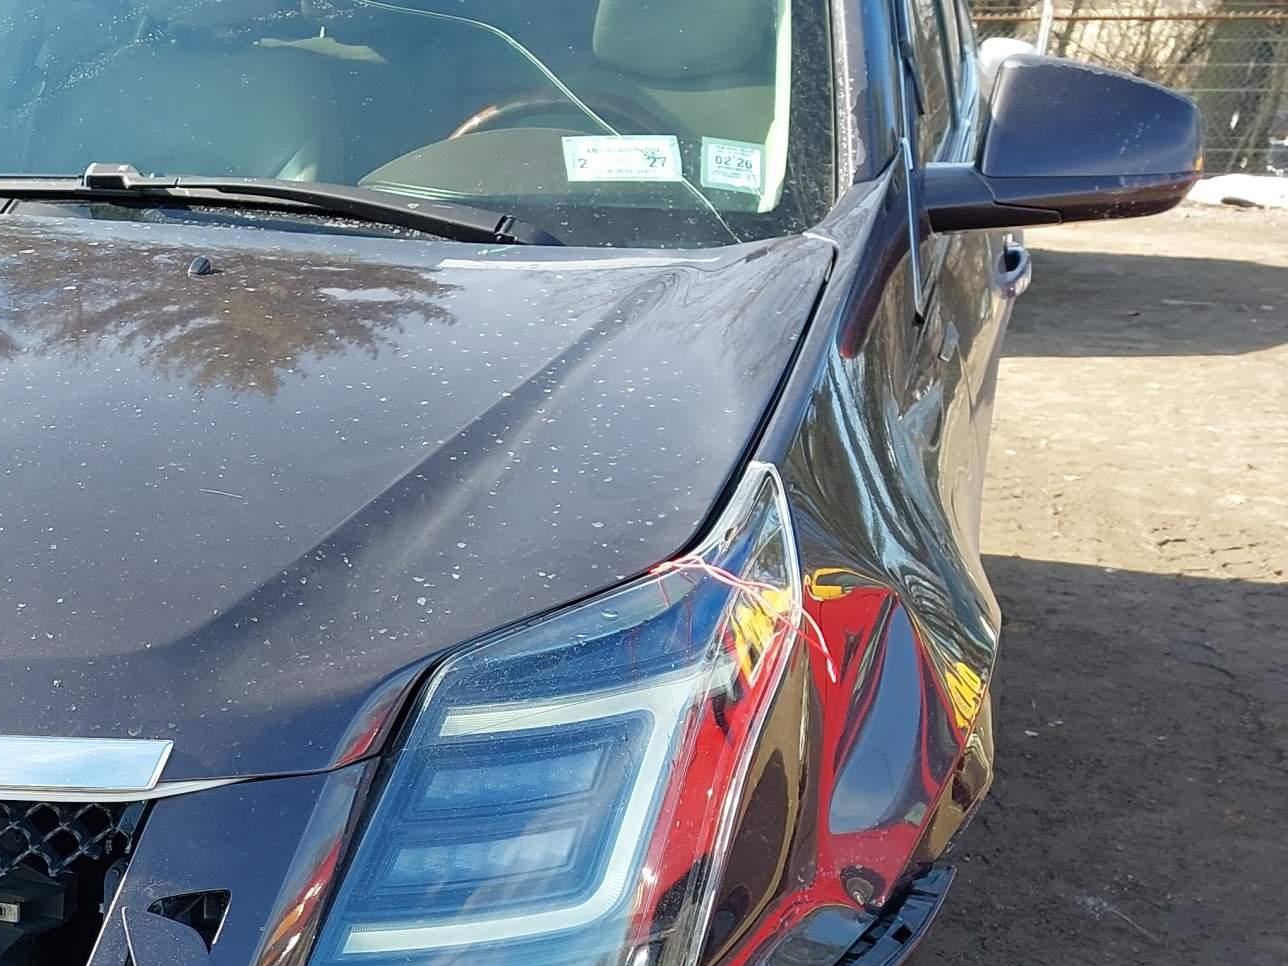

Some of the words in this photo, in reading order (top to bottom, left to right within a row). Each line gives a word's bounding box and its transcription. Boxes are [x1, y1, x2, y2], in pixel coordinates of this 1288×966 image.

[648, 157, 667, 168] 27
[715, 154, 731, 166] 02
[737, 158, 753, 169] 26
